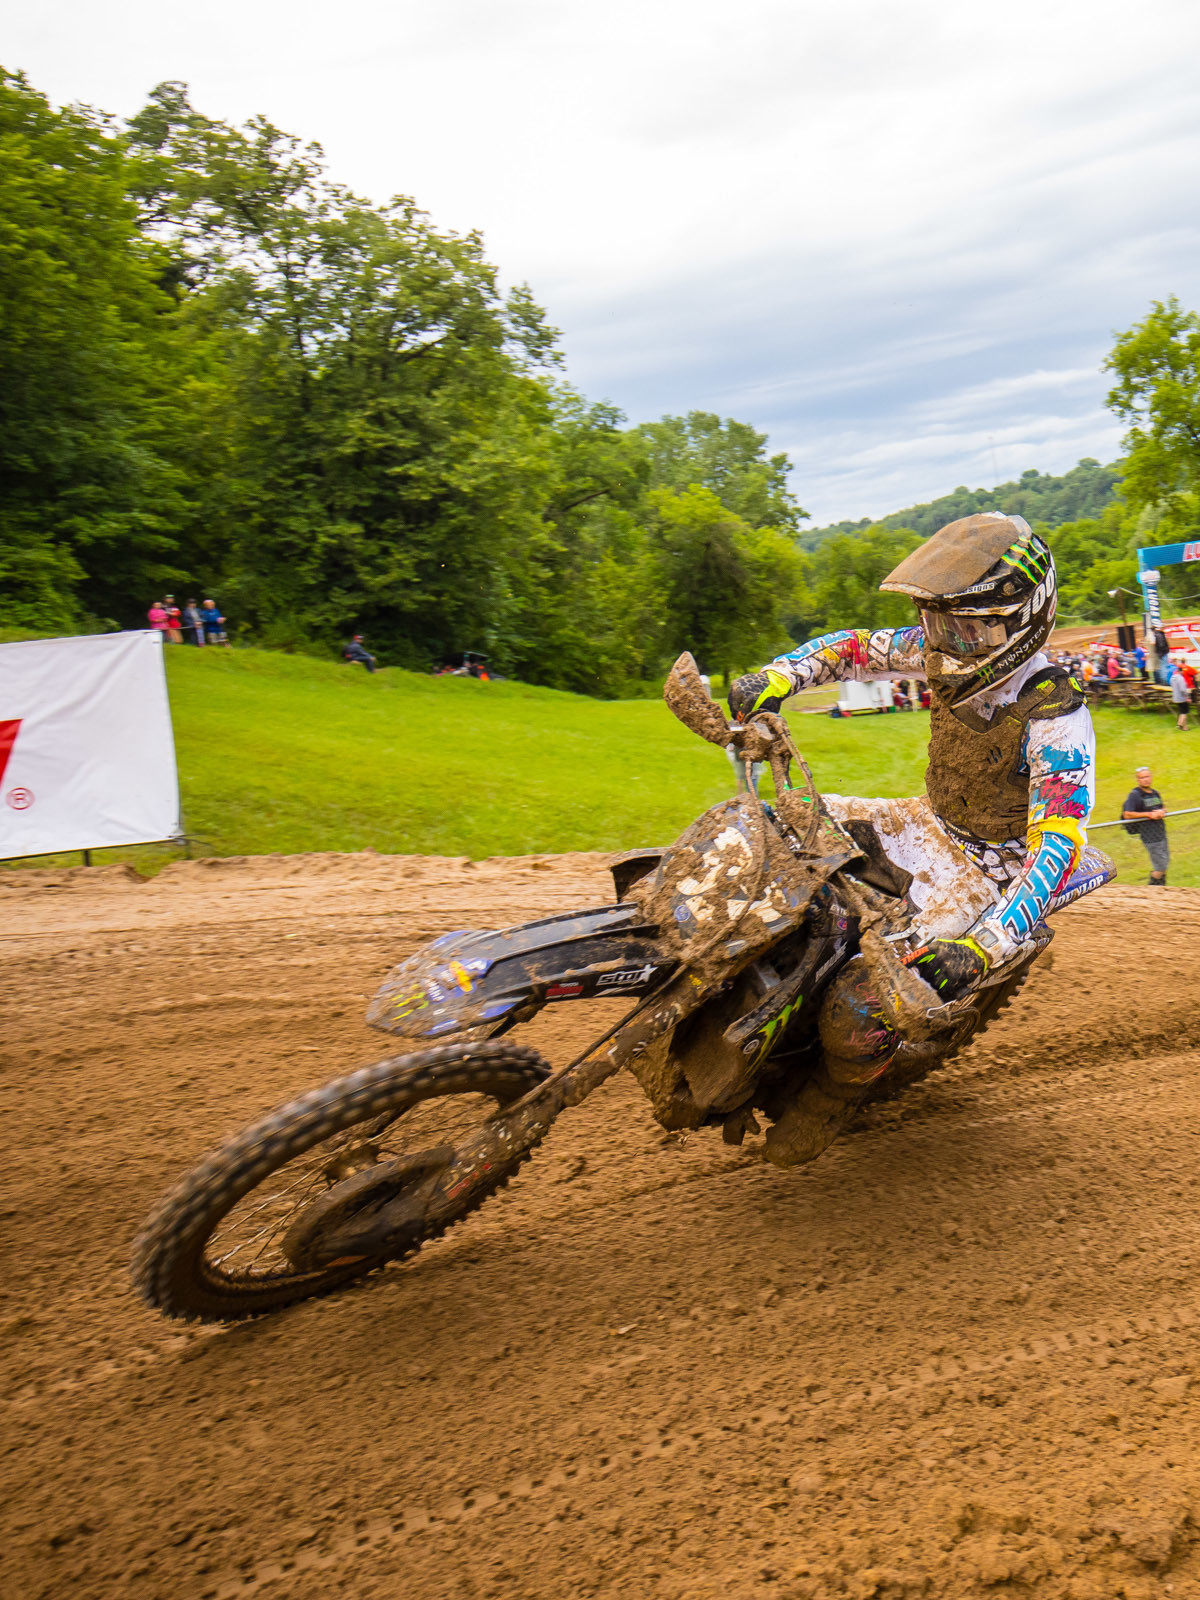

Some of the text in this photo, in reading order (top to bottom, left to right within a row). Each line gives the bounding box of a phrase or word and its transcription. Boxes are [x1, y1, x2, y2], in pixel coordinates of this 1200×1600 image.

[998, 625, 1046, 669] MONSTER
[1000, 831, 1075, 939] THOR
[1055, 874, 1104, 909] DUNLOP
